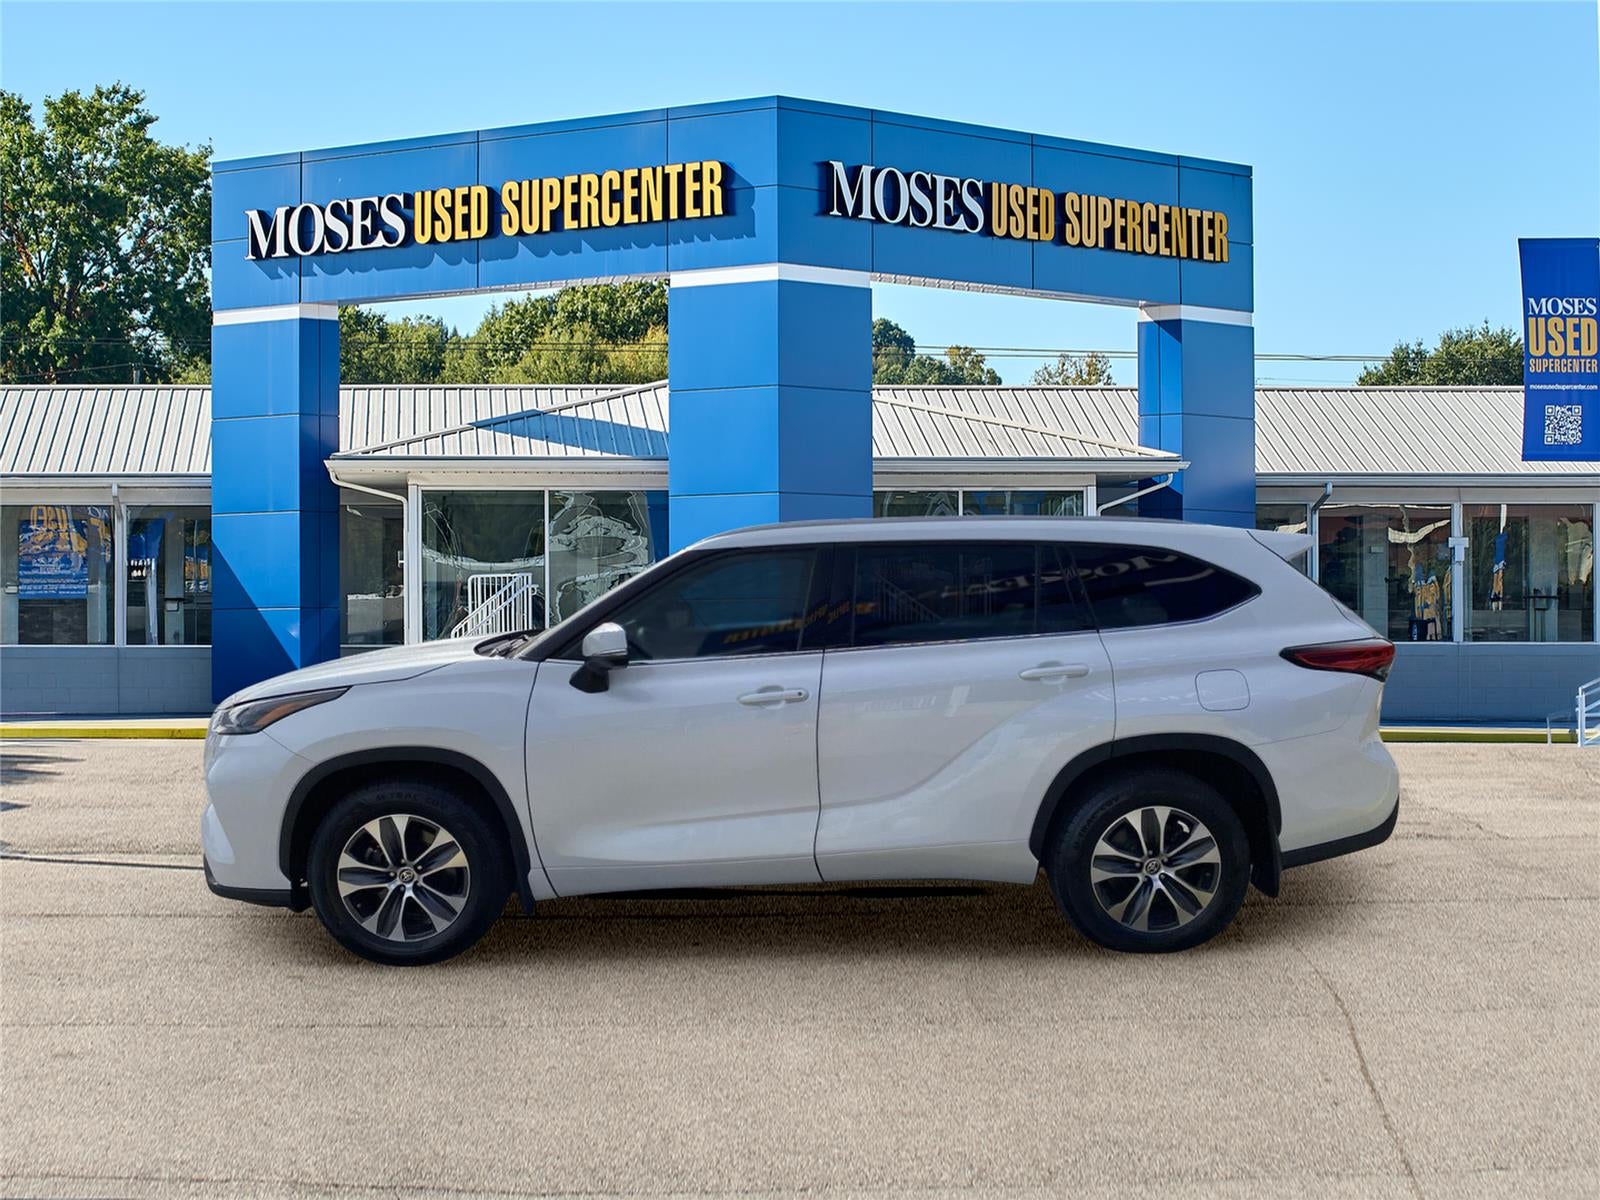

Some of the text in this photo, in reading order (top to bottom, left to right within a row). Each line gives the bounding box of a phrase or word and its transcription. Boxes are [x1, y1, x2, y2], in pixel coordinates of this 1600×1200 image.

[244, 160, 724, 261] MOSES USED SUPERCENTER
[828, 160, 1230, 263] MOSES USED SUPERCENTER
[1527, 297, 1598, 316] MOSES
[1527, 316, 1598, 357] USED
[1529, 358, 1598, 374] SUPERCENTER
